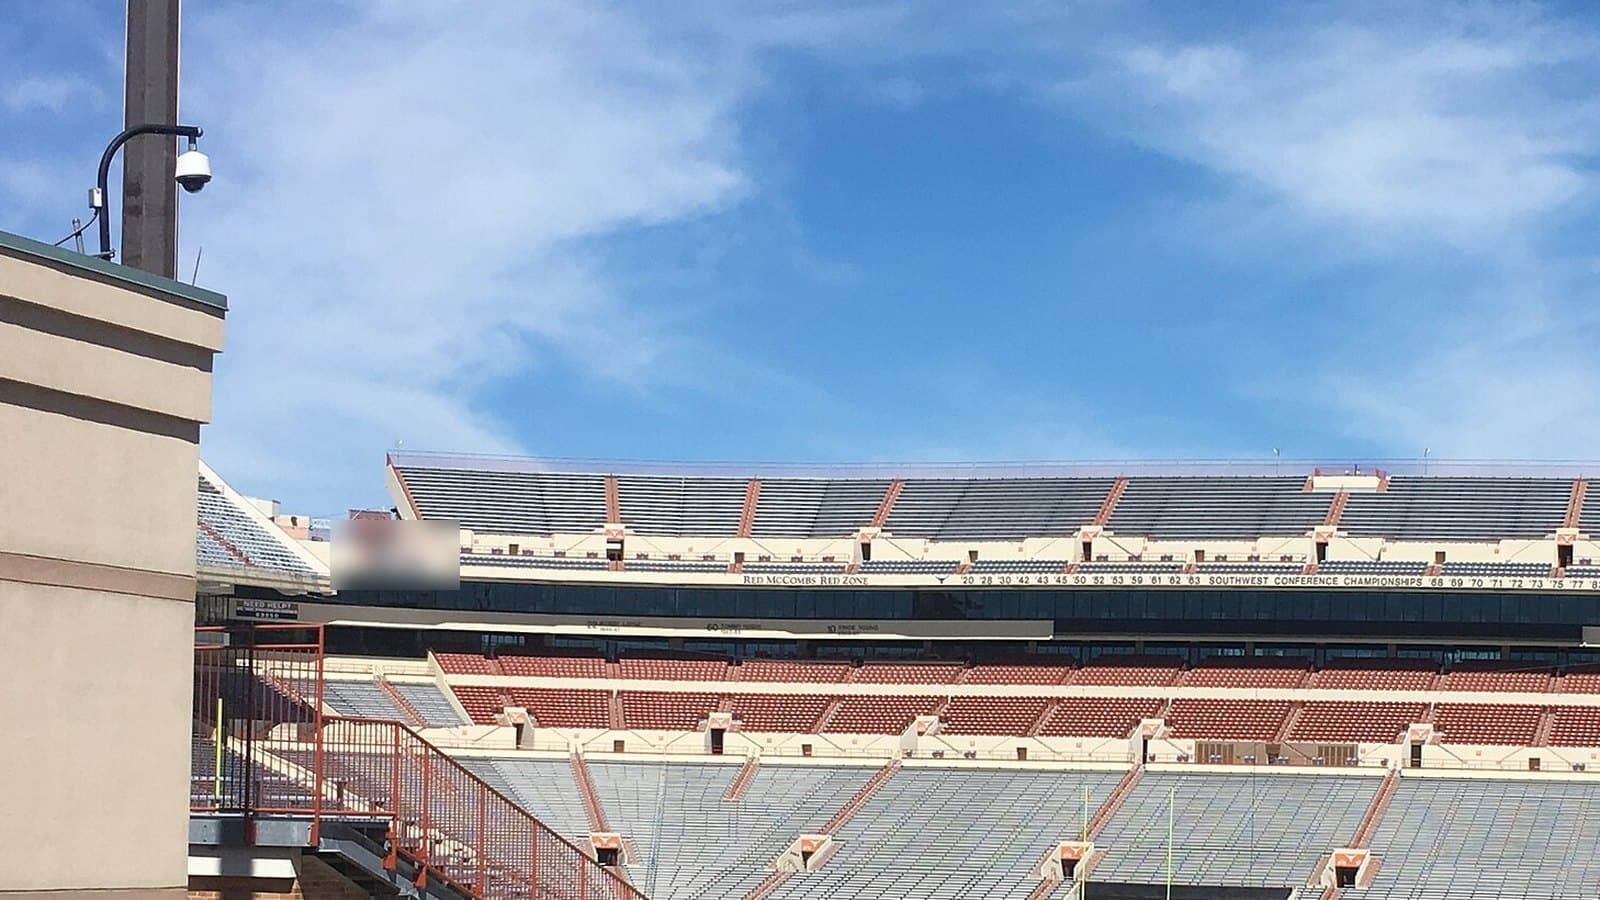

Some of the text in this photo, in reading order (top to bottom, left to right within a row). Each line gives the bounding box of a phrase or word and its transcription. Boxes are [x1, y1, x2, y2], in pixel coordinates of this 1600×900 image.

[743, 575, 764, 584] RED
[820, 576, 840, 585] RED
[842, 576, 869, 585] ZONE
[1209, 576, 1269, 585] SOUTHWEST
[1274, 576, 1338, 585] CONFERENCE
[1343, 577, 1423, 586] CHAMPIONSHIPS
